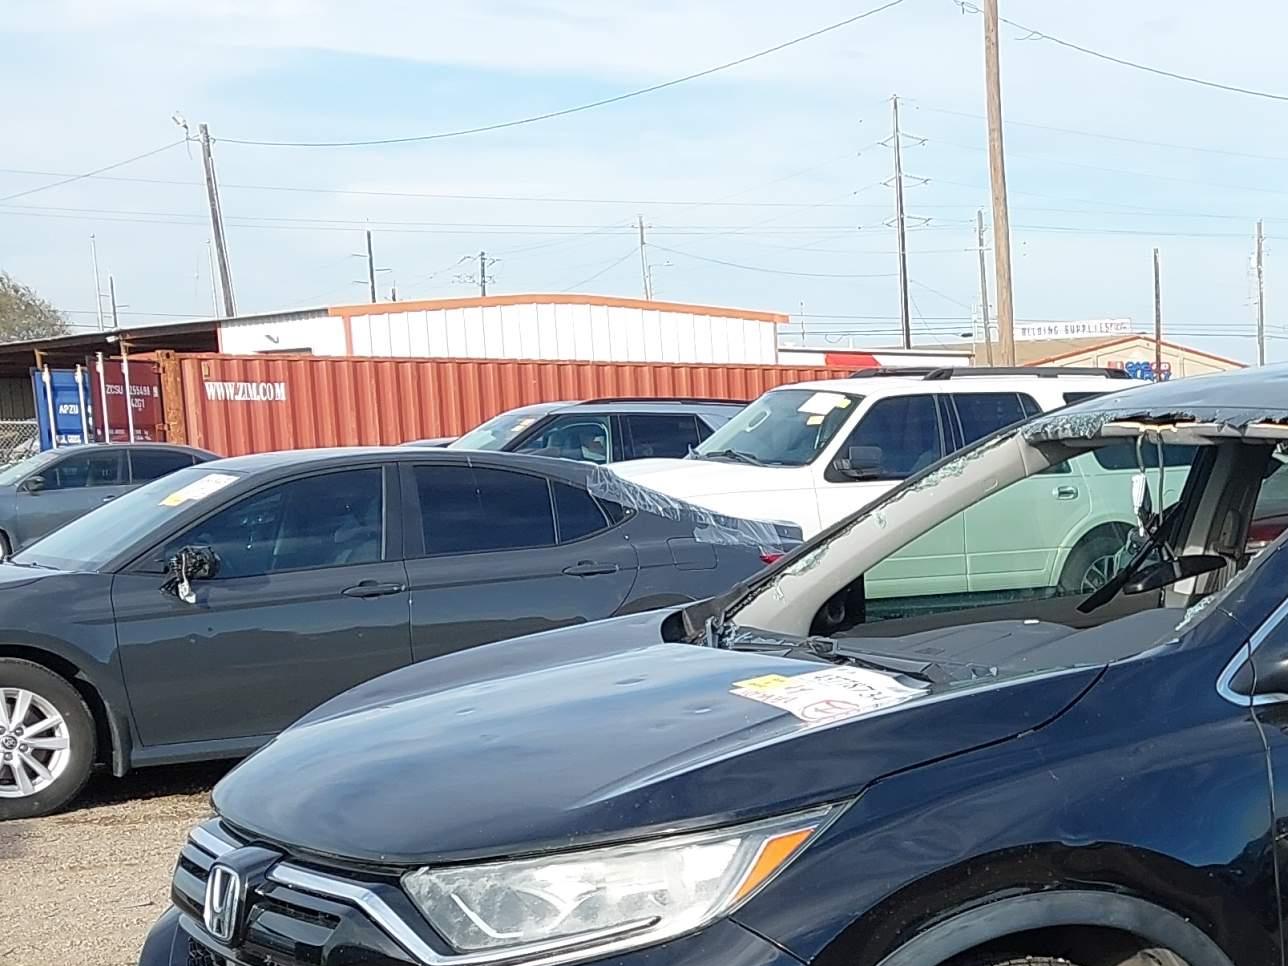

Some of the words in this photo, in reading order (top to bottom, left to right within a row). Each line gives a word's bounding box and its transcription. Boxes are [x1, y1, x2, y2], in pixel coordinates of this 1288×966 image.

[105, 384, 123, 395] ZCSU
[204, 382, 286, 400] WWW.ZIM.COM
[59, 404, 79, 414] APZU
